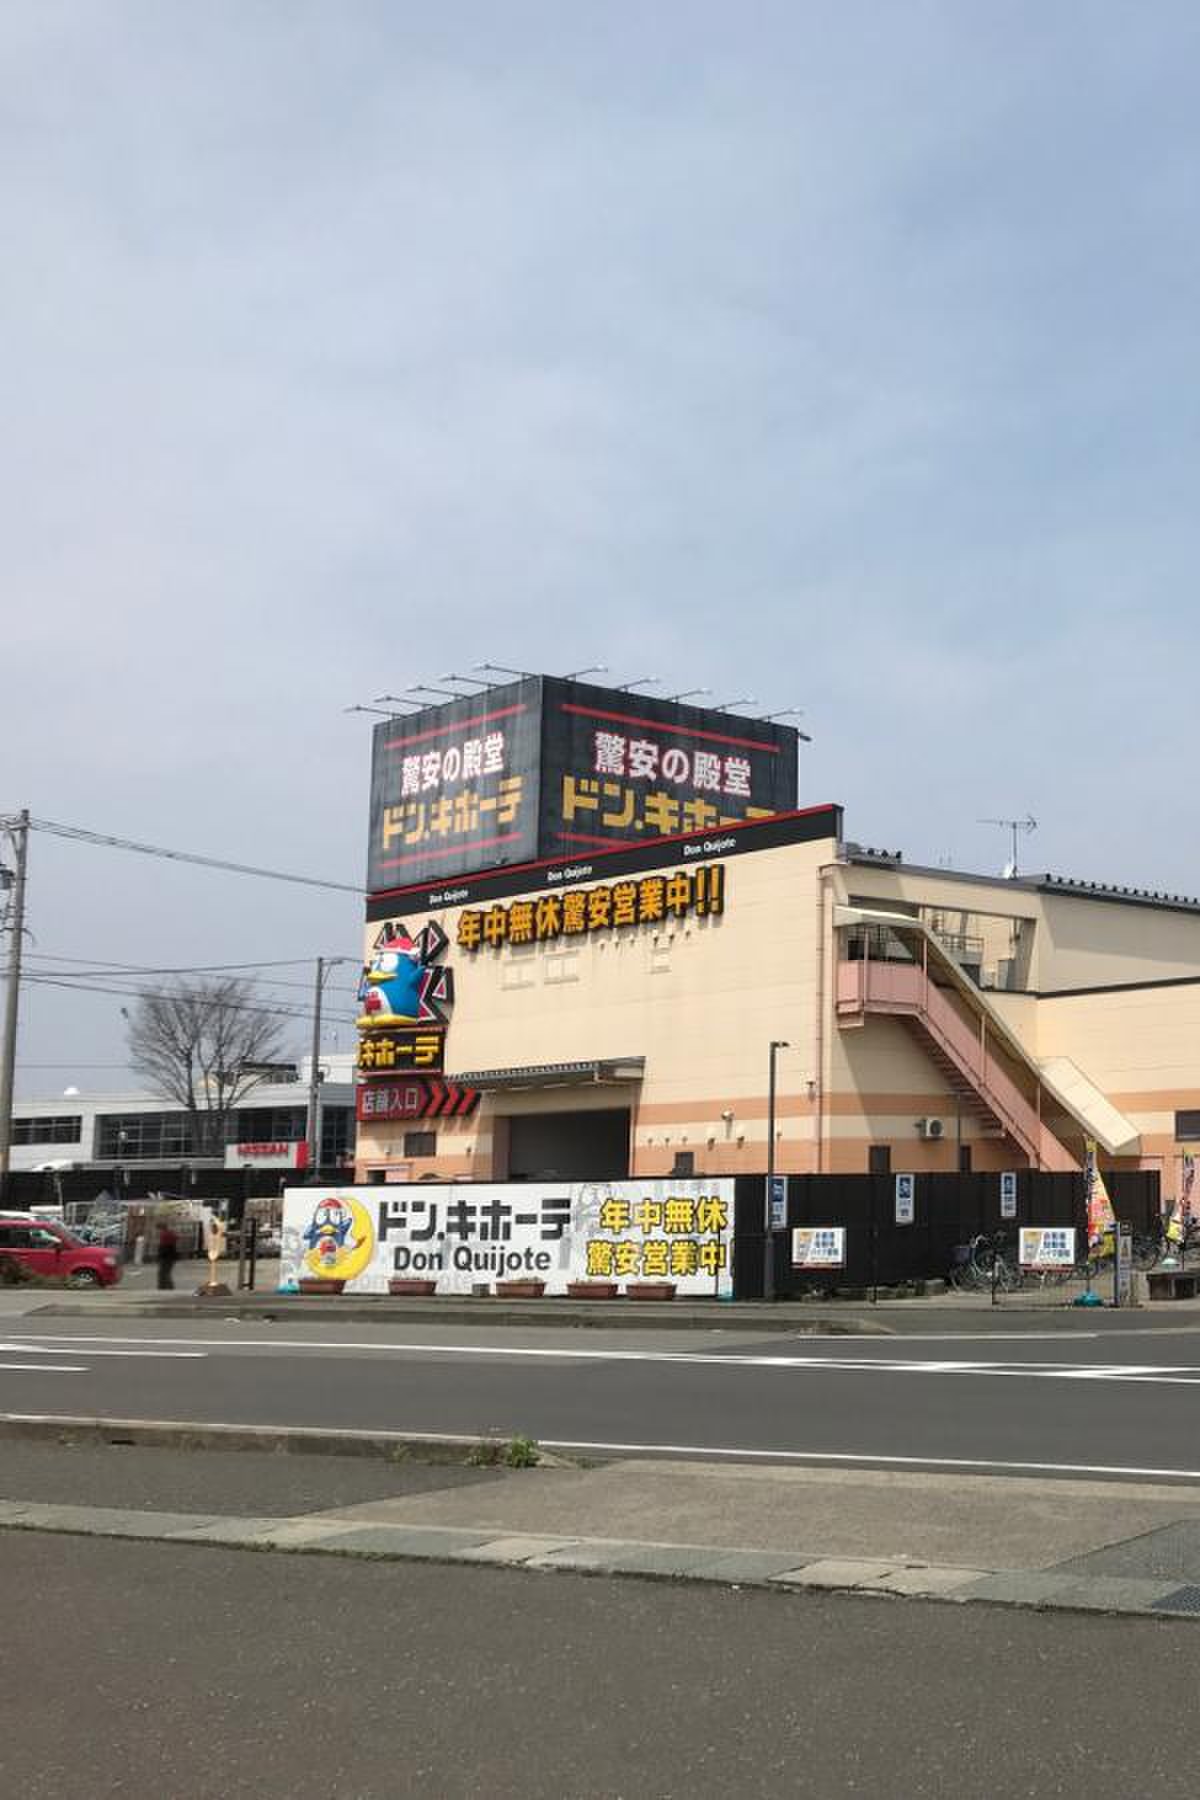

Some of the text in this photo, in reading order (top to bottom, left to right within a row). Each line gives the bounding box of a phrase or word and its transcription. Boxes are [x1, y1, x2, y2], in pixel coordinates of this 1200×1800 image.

[401, 731, 505, 798] 驚安の殿堂
[594, 731, 752, 799] 驚安の殿堂
[684, 844, 702, 856] Don
[599, 1197, 728, 1235] 年中無休
[392, 1245, 552, 1276] Don Quijote
